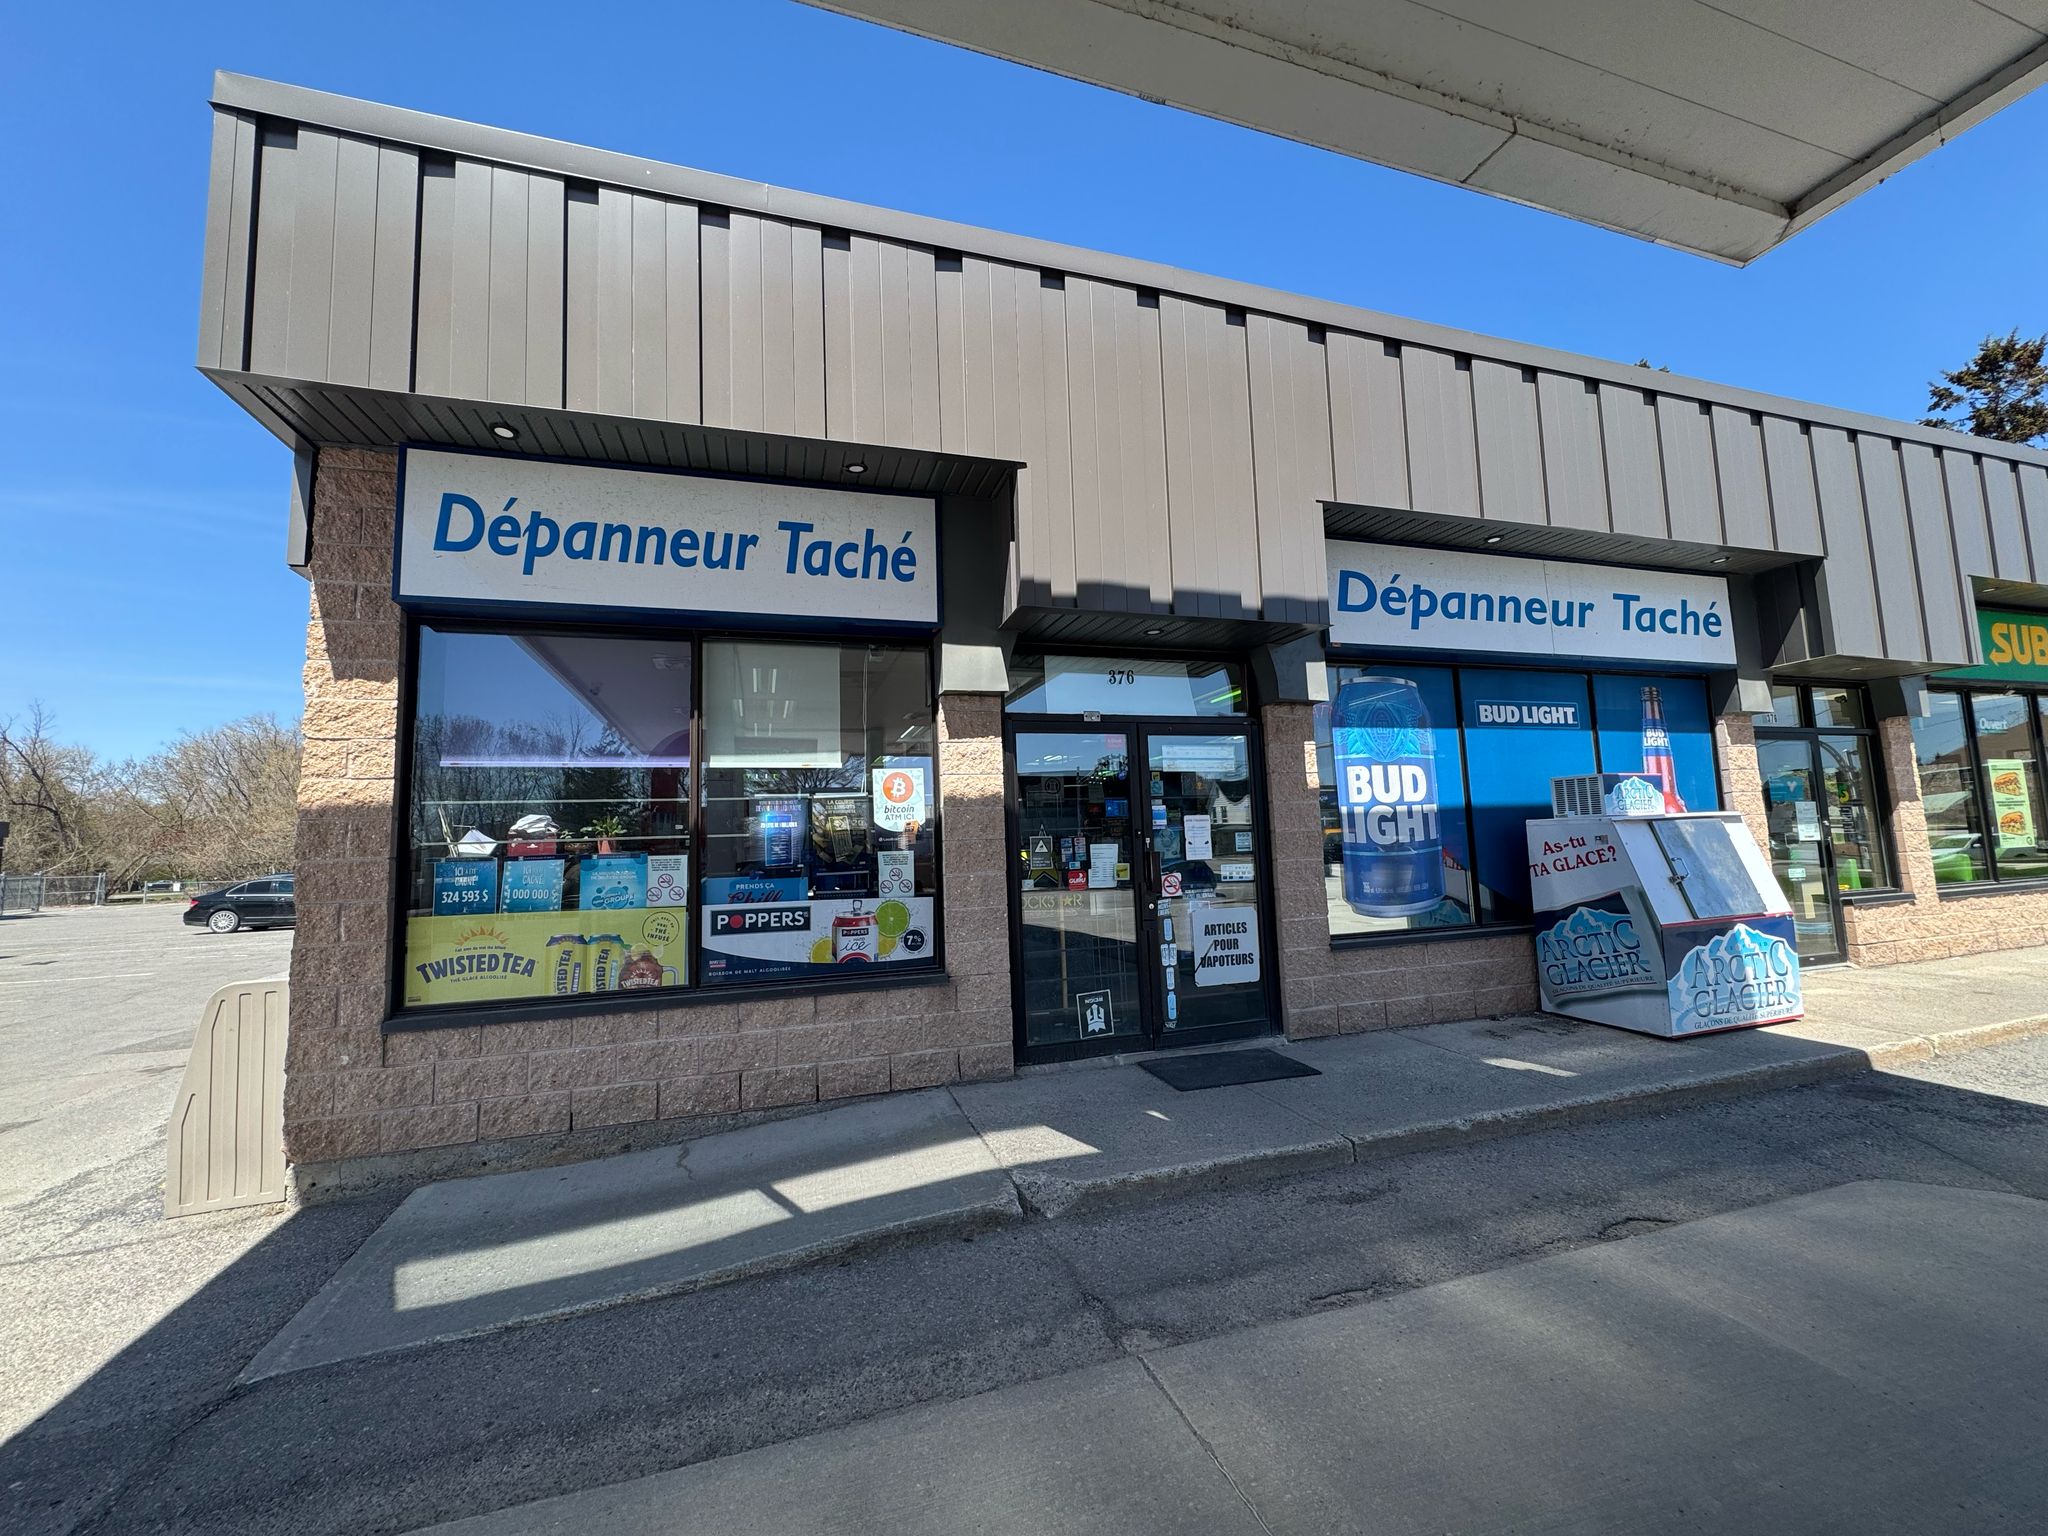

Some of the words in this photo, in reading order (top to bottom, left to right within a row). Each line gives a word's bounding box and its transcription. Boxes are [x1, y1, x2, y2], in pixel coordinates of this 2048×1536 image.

[433, 492, 759, 576] Dépanneur
[777, 520, 917, 583] Taché
[1336, 569, 1595, 630] Dépanneur
[1612, 592, 1722, 638] Taché
[1108, 669, 1135, 685] 376
[1479, 704, 1520, 723] BUD
[1522, 705, 1576, 725] LIGHT
[1646, 728, 1665, 738] BUD
[1643, 737, 1669, 747] LIGHT
[1346, 764, 1427, 803] BUD
[1616, 784, 1653, 800] ARCTIC
[884, 804, 915, 814] bitcoin
[1617, 799, 1653, 811] GLACIER
[885, 813, 902, 821] ATM
[1341, 804, 1438, 845] LIGHT
[1543, 836, 1587, 856] As-tu
[1530, 862, 1551, 878] TA
[1552, 845, 1617, 872] GLACE?
[441, 891, 460, 903] 324
[462, 890, 480, 902] 593
[482, 889, 489, 902] $
[512, 888, 530, 899] 000
[532, 888, 549, 899] 000
[717, 910, 805, 930] POPPERS
[1204, 921, 1248, 937] ARTICLES
[840, 940, 871, 951] ice
[906, 935, 922, 946] 7%
[1213, 938, 1239, 951] POUR
[1541, 919, 1640, 963] ARCTIC
[416, 953, 500, 984] TWISTED
[501, 952, 537, 978] TEA
[1200, 952, 1254, 969] VAPOTEURS
[1546, 951, 1652, 986] GLACIER
[1690, 939, 1789, 989] ARCTIC
[1693, 979, 1793, 1018] GLACIER
[1694, 1016, 1724, 1029] GLAÇONS
[1724, 1015, 1732, 1025] DE
[1732, 1012, 1758, 1025] QUALITÉ
